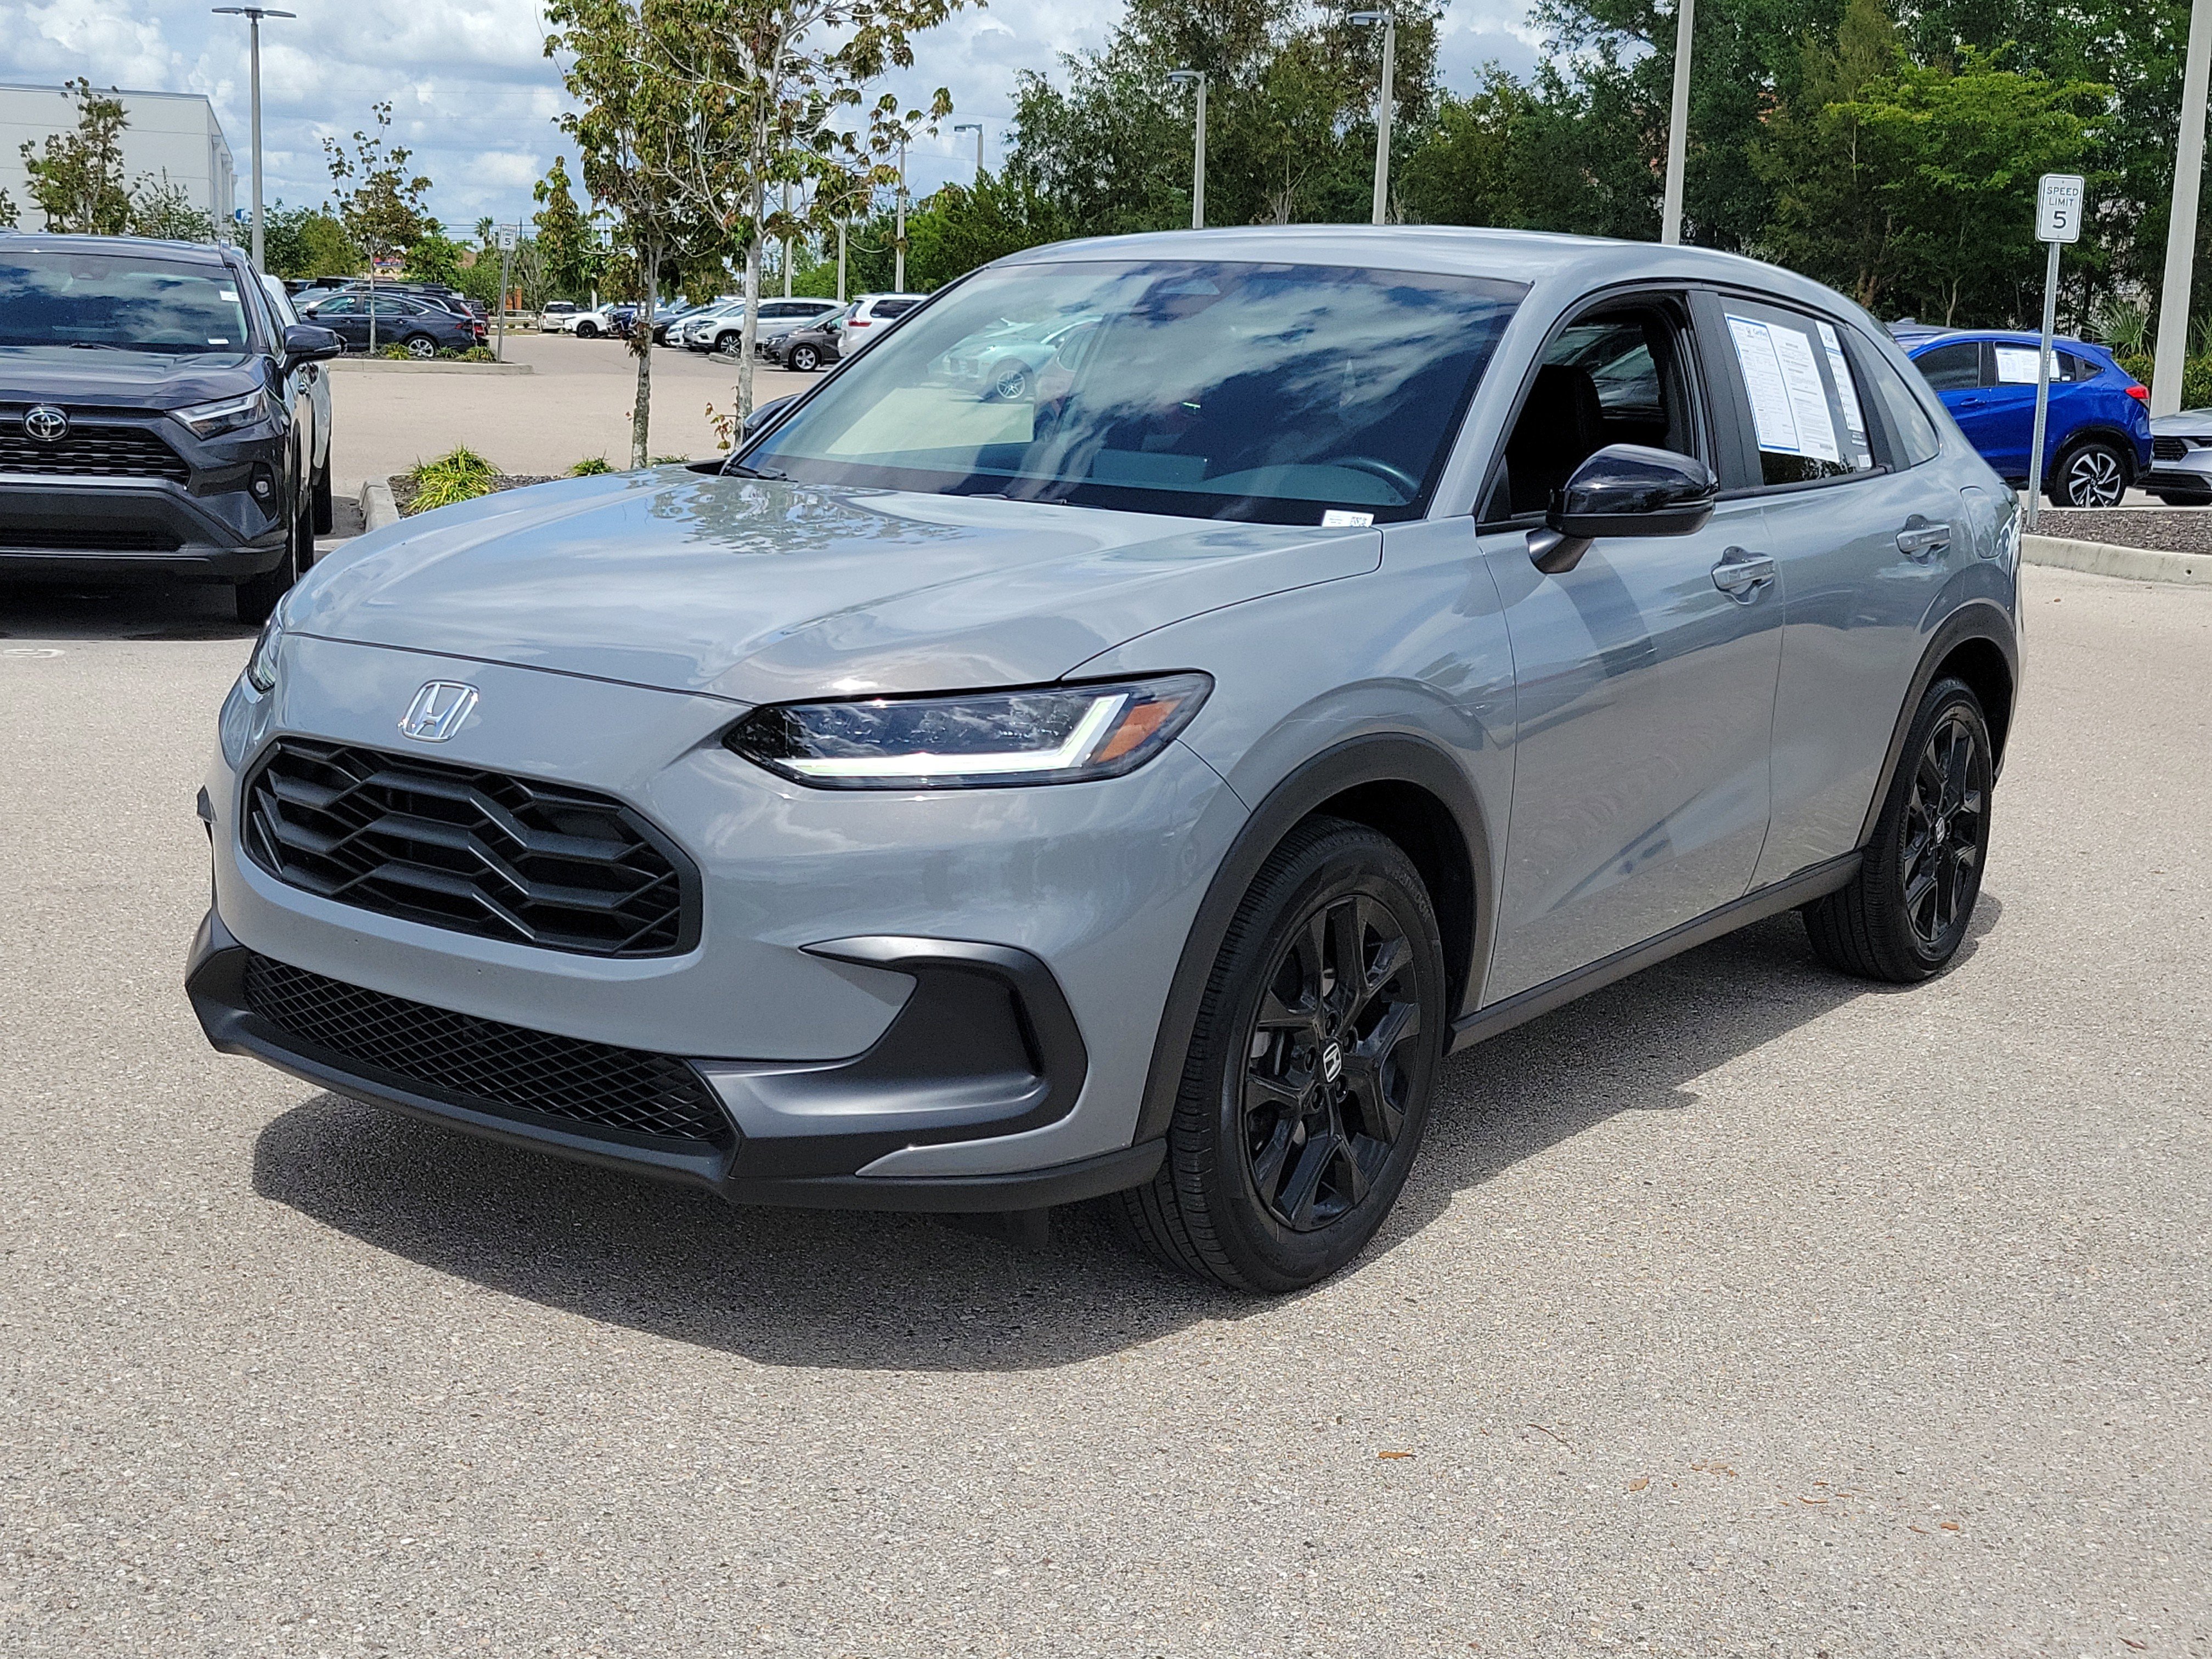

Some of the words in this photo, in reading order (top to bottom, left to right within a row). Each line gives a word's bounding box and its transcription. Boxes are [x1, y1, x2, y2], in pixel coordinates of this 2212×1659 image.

[2046, 187, 2079, 196] SPEED
[2049, 198, 2074, 207] LIMIT
[2052, 211, 2067, 229] 5
[504, 238, 511, 246] 5
